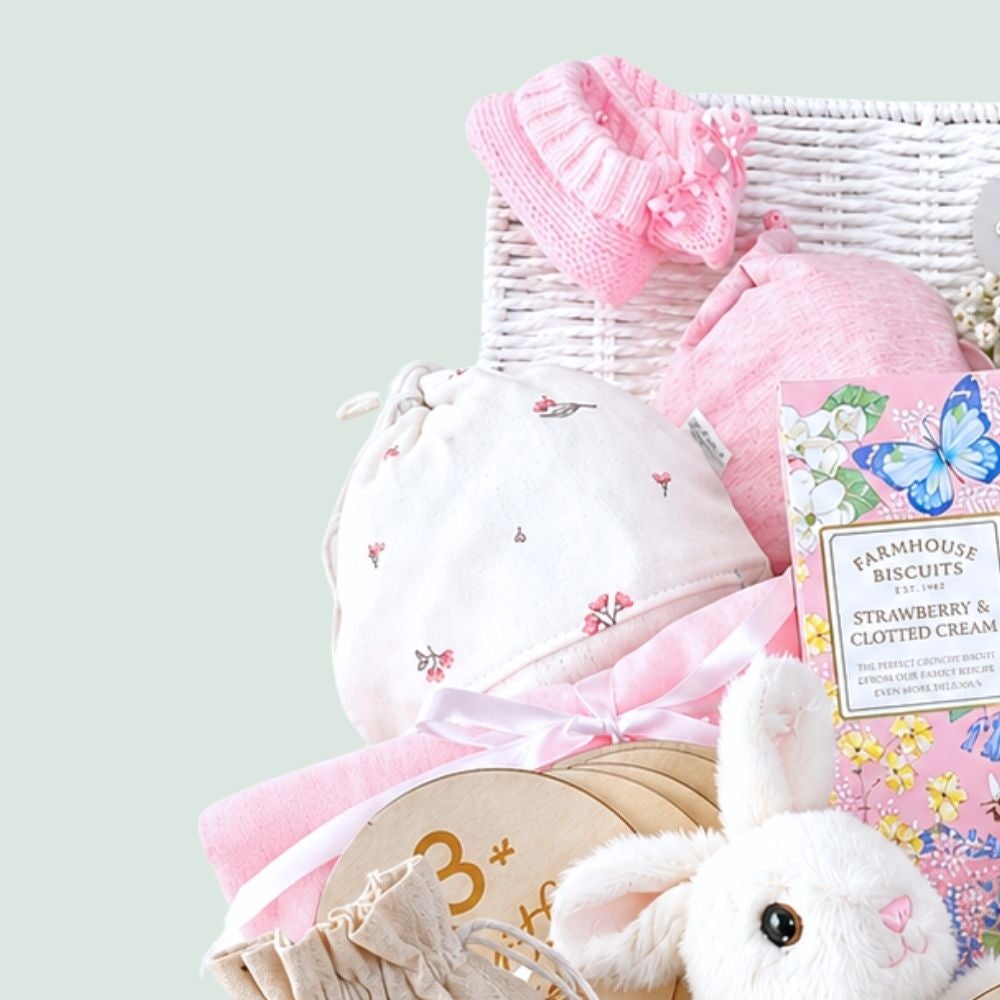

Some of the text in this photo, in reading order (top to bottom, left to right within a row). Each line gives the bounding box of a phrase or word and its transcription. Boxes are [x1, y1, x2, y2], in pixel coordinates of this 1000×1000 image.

[852, 538, 978, 572] FARMHOUSE
[873, 562, 964, 583] BISCUITS
[853, 600, 990, 625] STRAWBERRY &
[850, 619, 998, 647] CLOTTED CREAM
